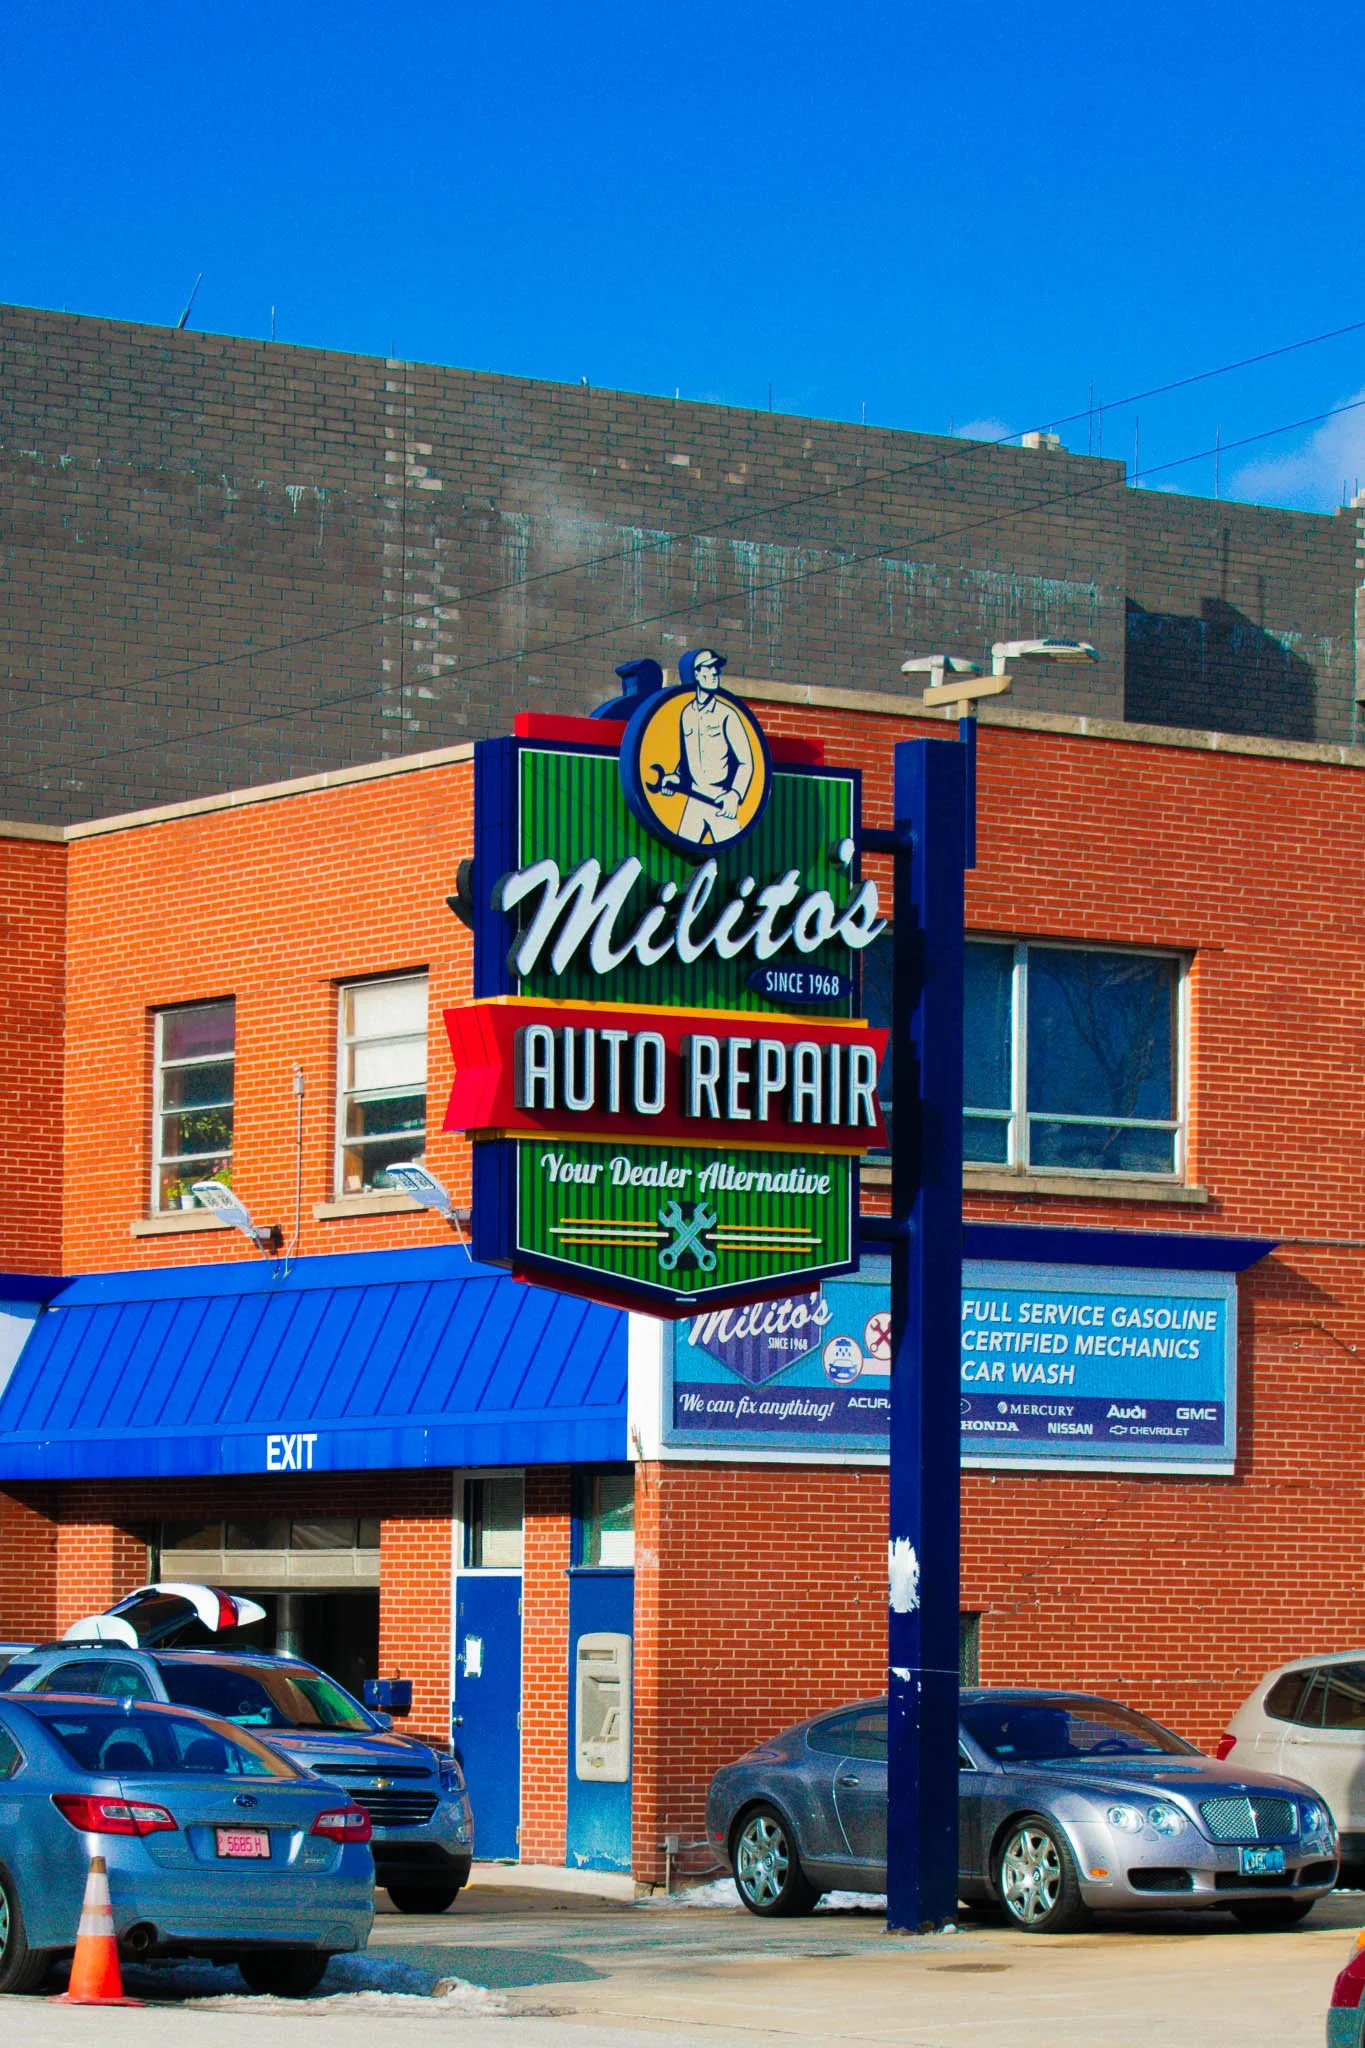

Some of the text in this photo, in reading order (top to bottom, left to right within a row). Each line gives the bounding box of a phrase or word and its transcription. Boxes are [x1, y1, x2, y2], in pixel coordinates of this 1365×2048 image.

[502, 838, 887, 976] Milito's
[766, 971, 839, 996] SINCE 1968
[523, 1023, 878, 1127] AUTO REPAIR
[540, 1153, 831, 1195] Your Dealer Alternative
[961, 1300, 1217, 1331] FULL SERVICE GASOLINE
[768, 1337, 807, 1350] SINCE 1968
[961, 1330, 1200, 1359] CERTIFIED MECHANICS
[961, 1360, 1075, 1385] CAR WASH
[679, 1393, 835, 1421] We can fix anything!
[1010, 1404, 1075, 1416] MERCURY
[1106, 1404, 1146, 1419] Audi
[1176, 1407, 1217, 1420] GMC
[960, 1420, 1019, 1431] HONDA
[1047, 1422, 1093, 1434] NISSAN
[1129, 1426, 1190, 1436] CHEVROLET
[266, 1433, 318, 1470] EXIT
